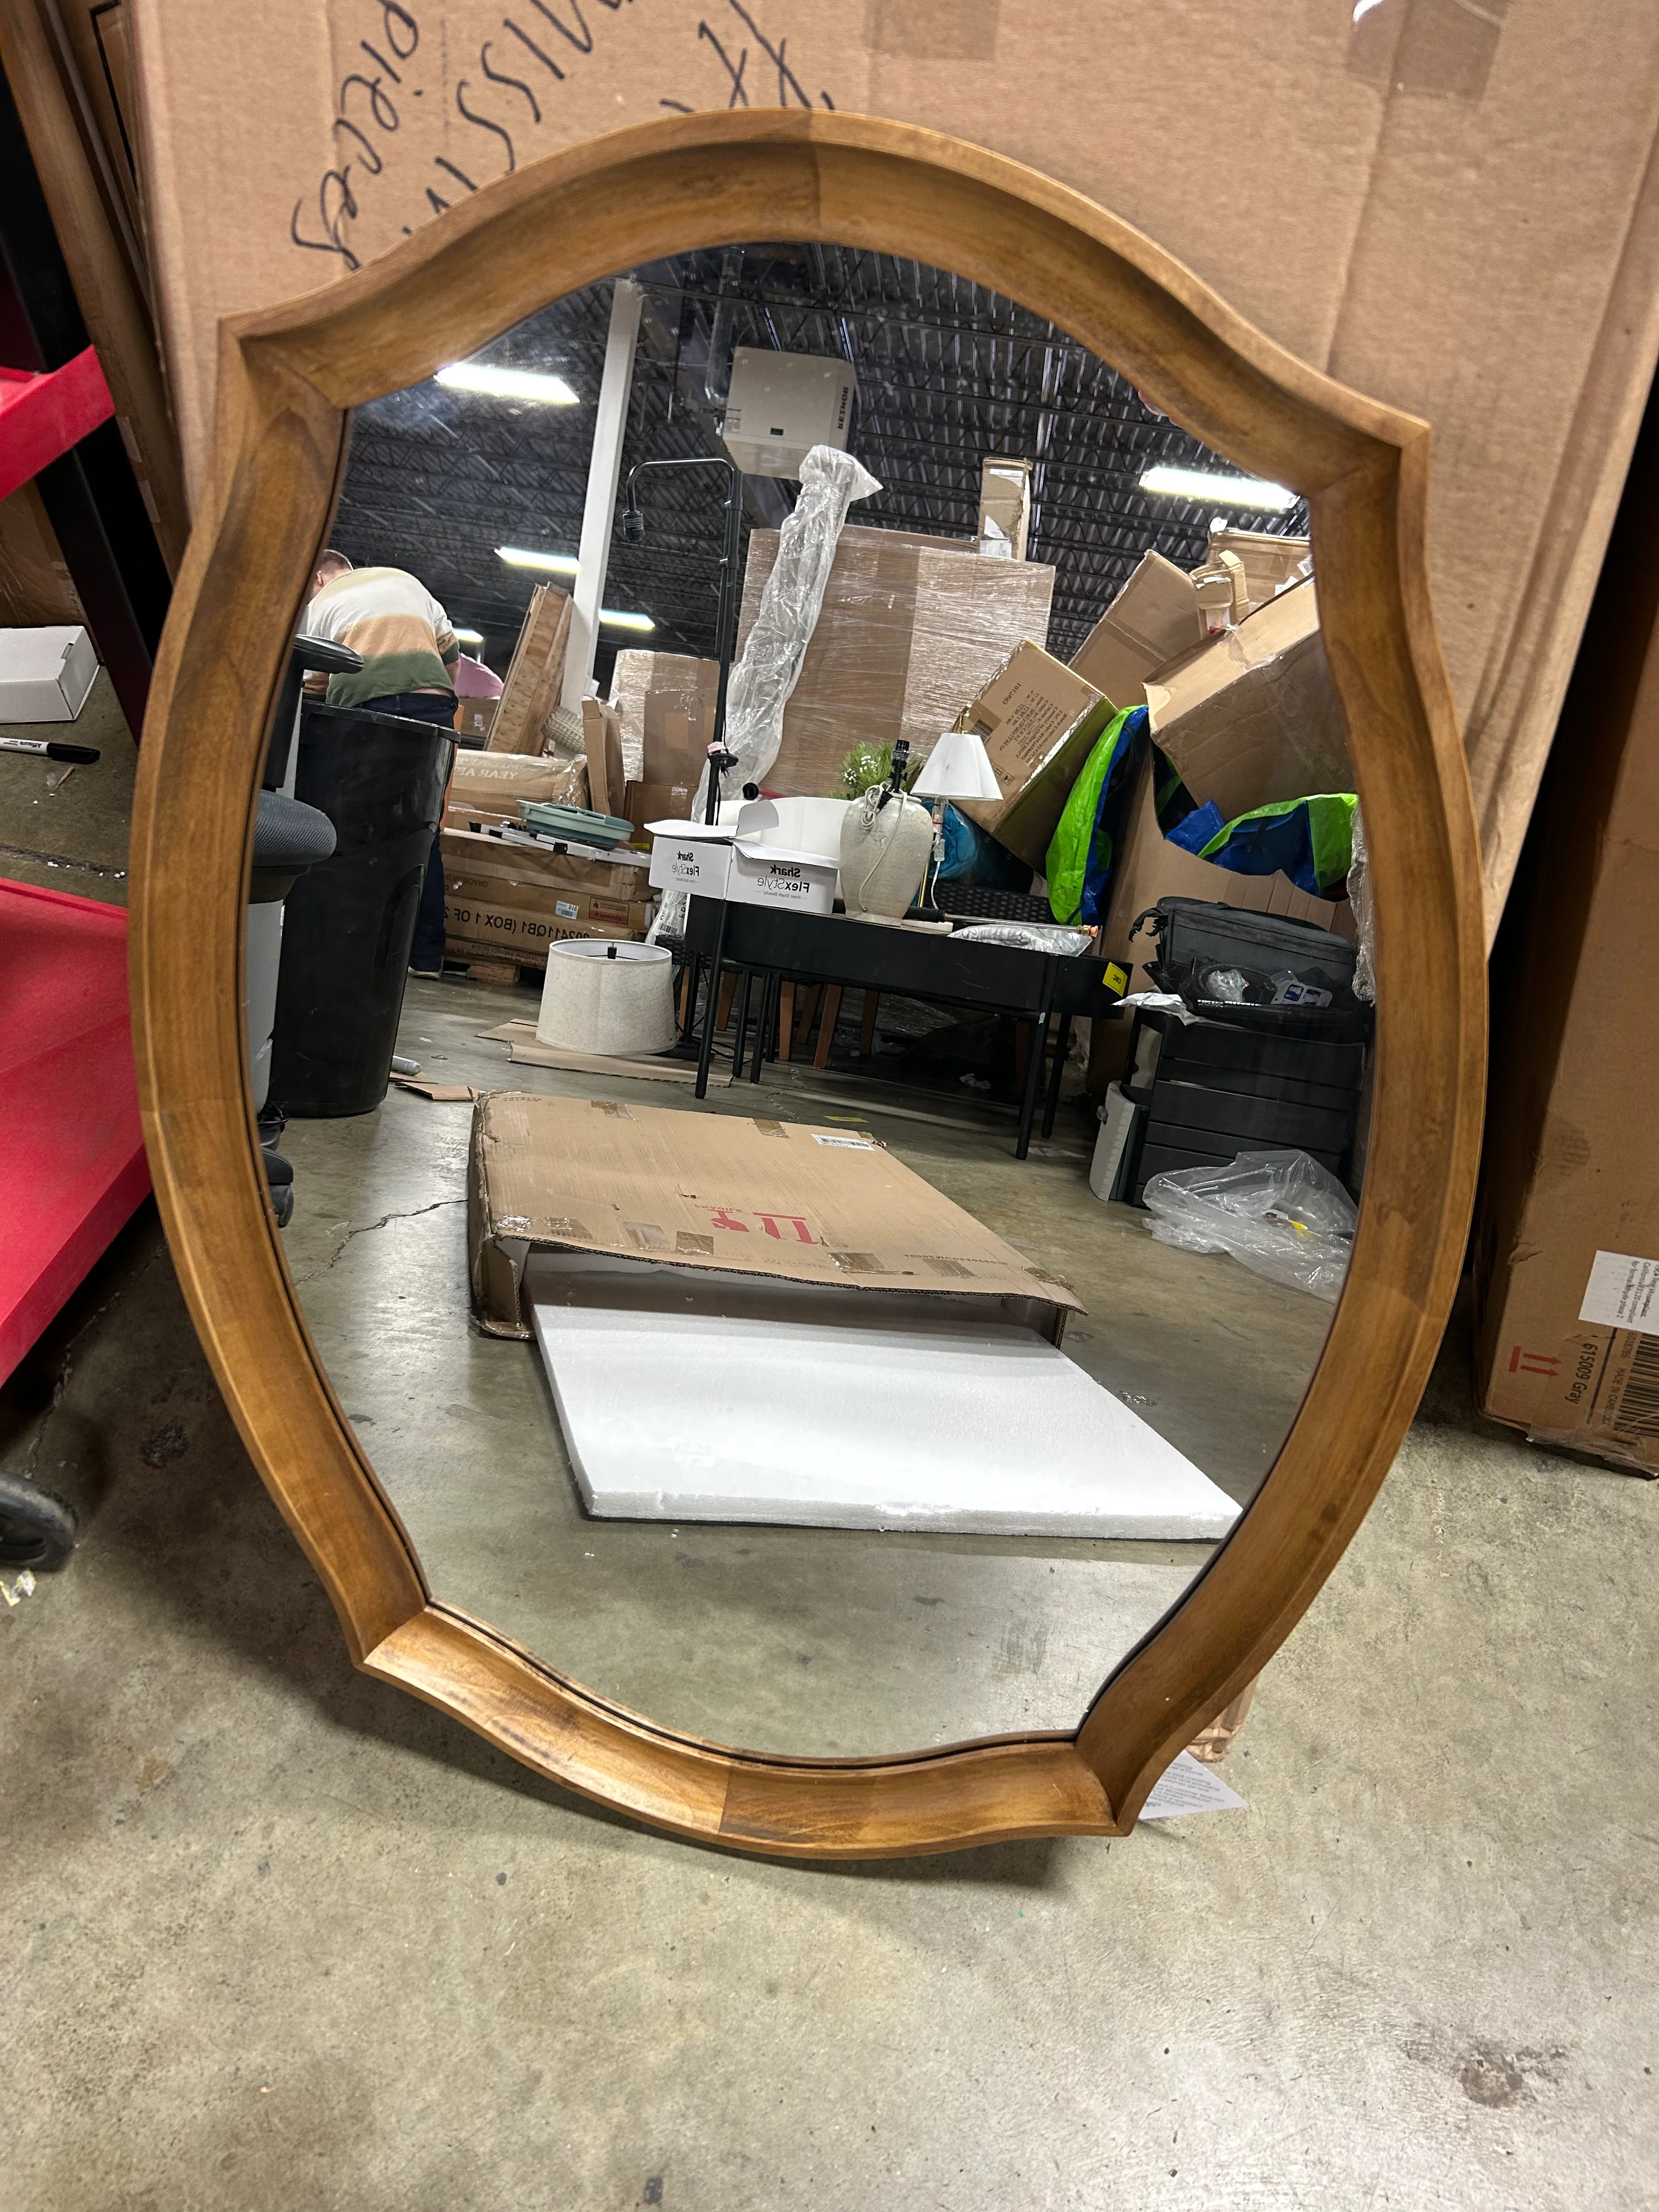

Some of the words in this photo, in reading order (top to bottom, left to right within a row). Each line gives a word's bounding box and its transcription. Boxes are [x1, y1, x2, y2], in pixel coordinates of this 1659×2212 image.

[1631, 1260, 1639, 1268] for
[1617, 1300, 1627, 1315] phase
[1626, 1300, 1638, 1324] compliant
[1575, 1342, 1599, 1381] 615009
[1612, 1367, 1626, 1386] MADE
[1564, 1380, 1588, 1406] Gray
[1610, 1385, 1620, 1394] IN
